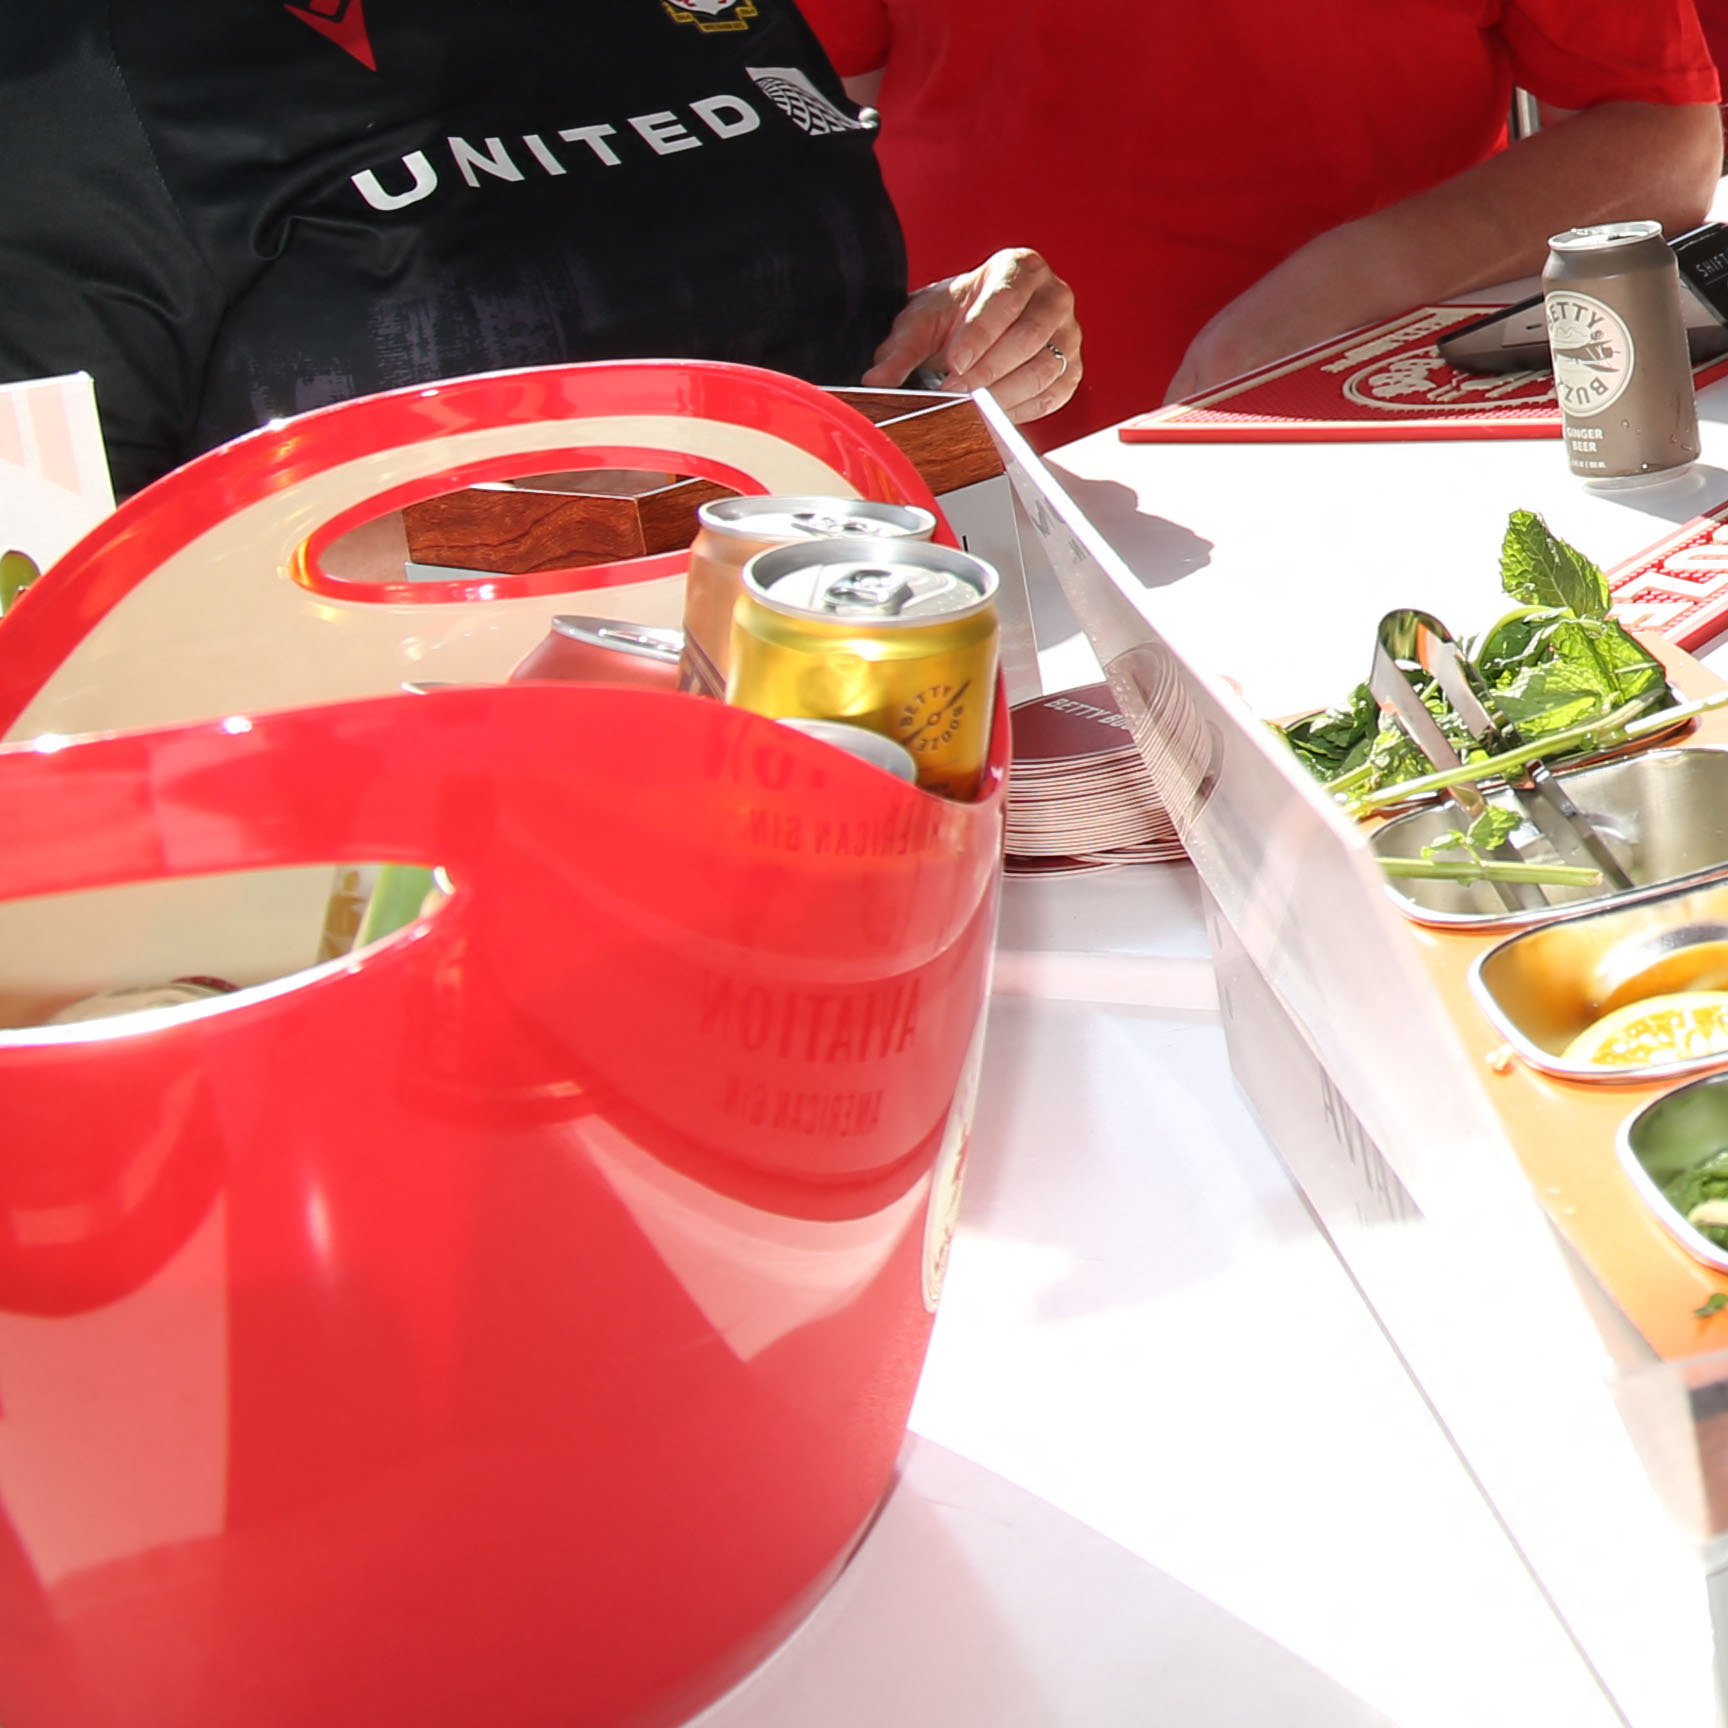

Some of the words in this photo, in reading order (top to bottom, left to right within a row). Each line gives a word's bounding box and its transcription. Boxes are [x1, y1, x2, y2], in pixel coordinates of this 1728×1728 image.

[351, 94, 761, 211] UNITED
[1572, 440, 1597, 452] BEER
[1045, 698, 1114, 719] BETTY
